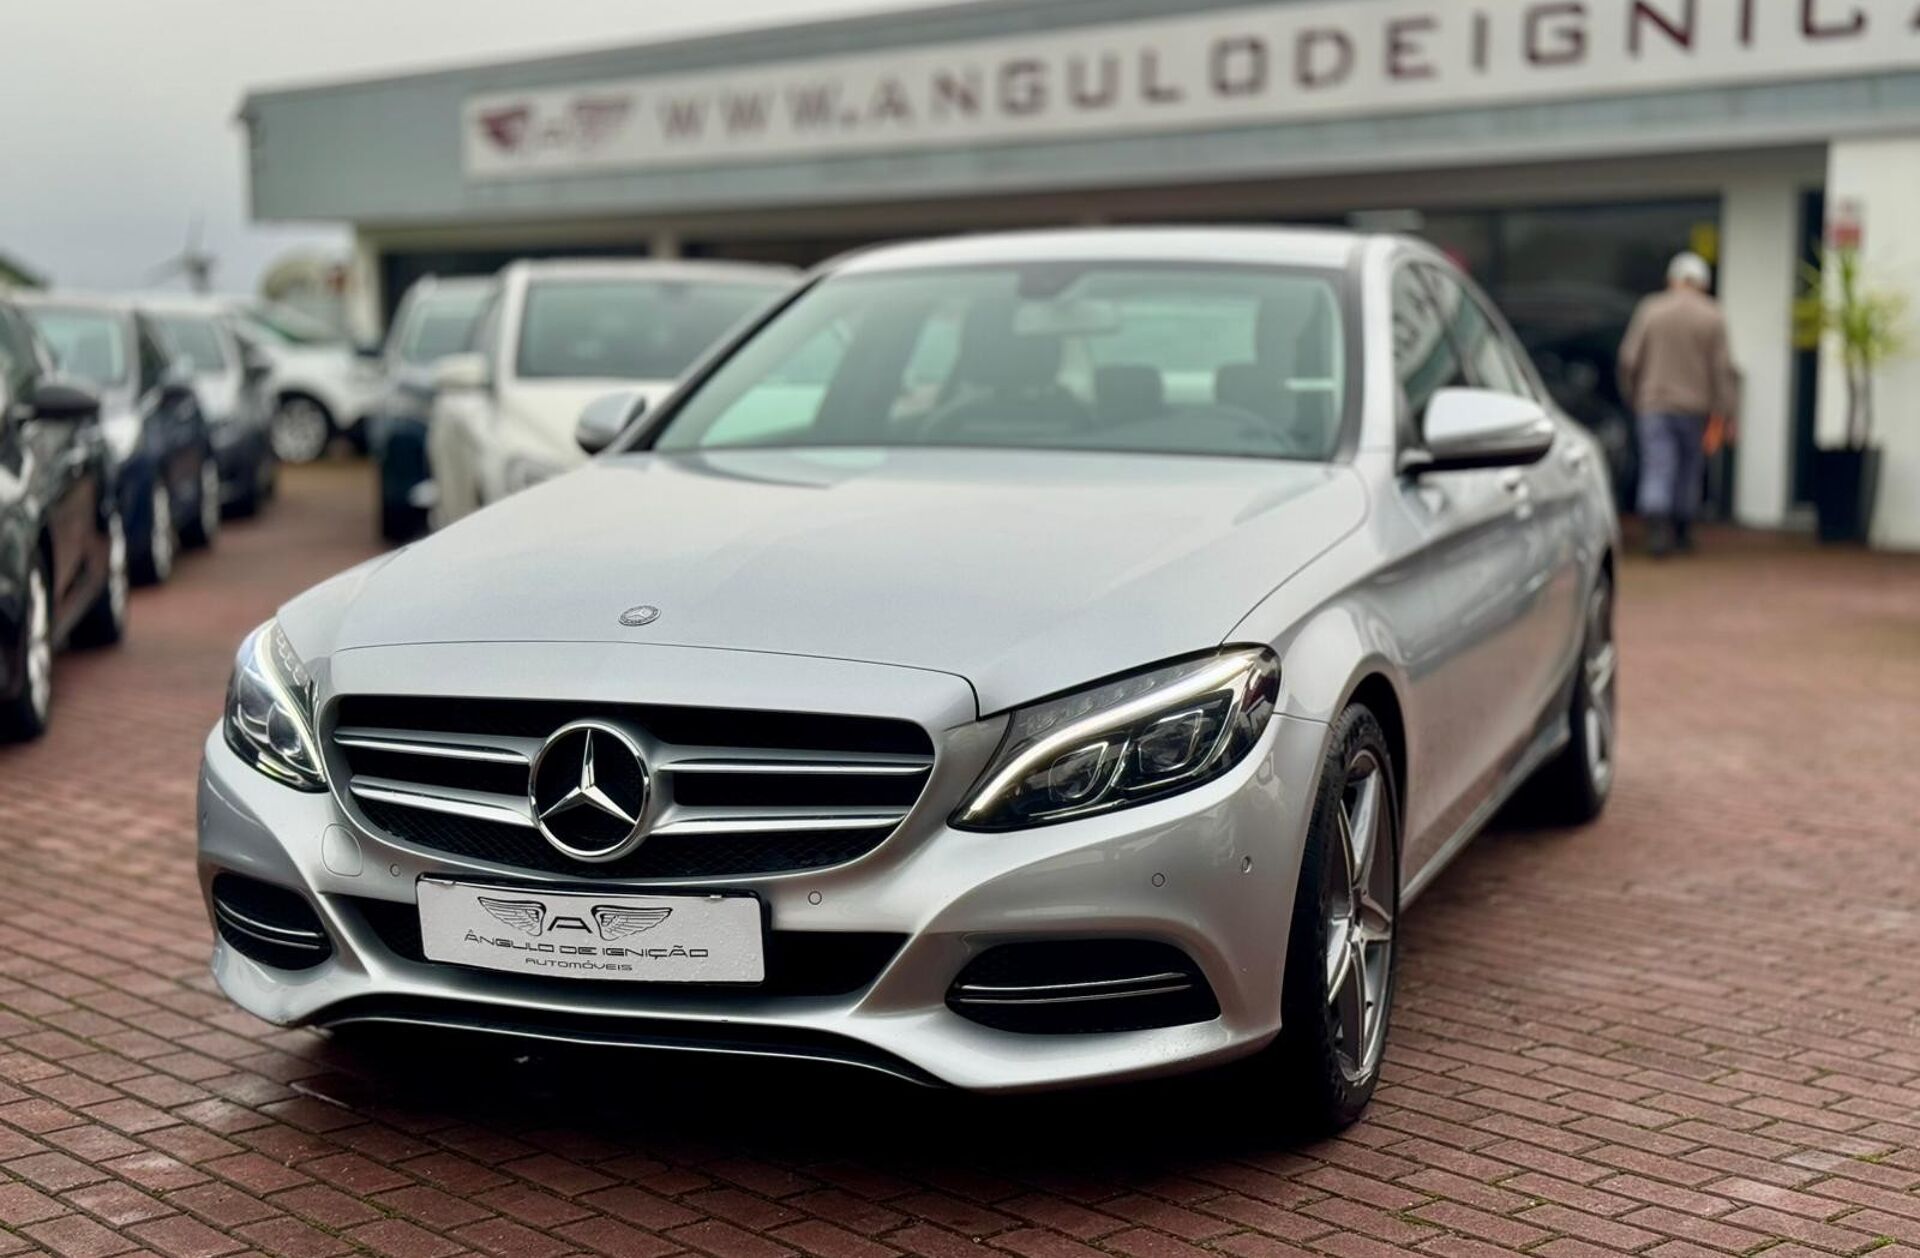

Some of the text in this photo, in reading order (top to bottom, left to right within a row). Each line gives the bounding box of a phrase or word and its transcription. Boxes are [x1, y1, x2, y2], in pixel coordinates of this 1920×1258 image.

[656, 0, 1920, 139] WWW.ANGULODEIGNIC
[464, 929, 709, 960] ÂNGULO DE IGNIÇÃO
